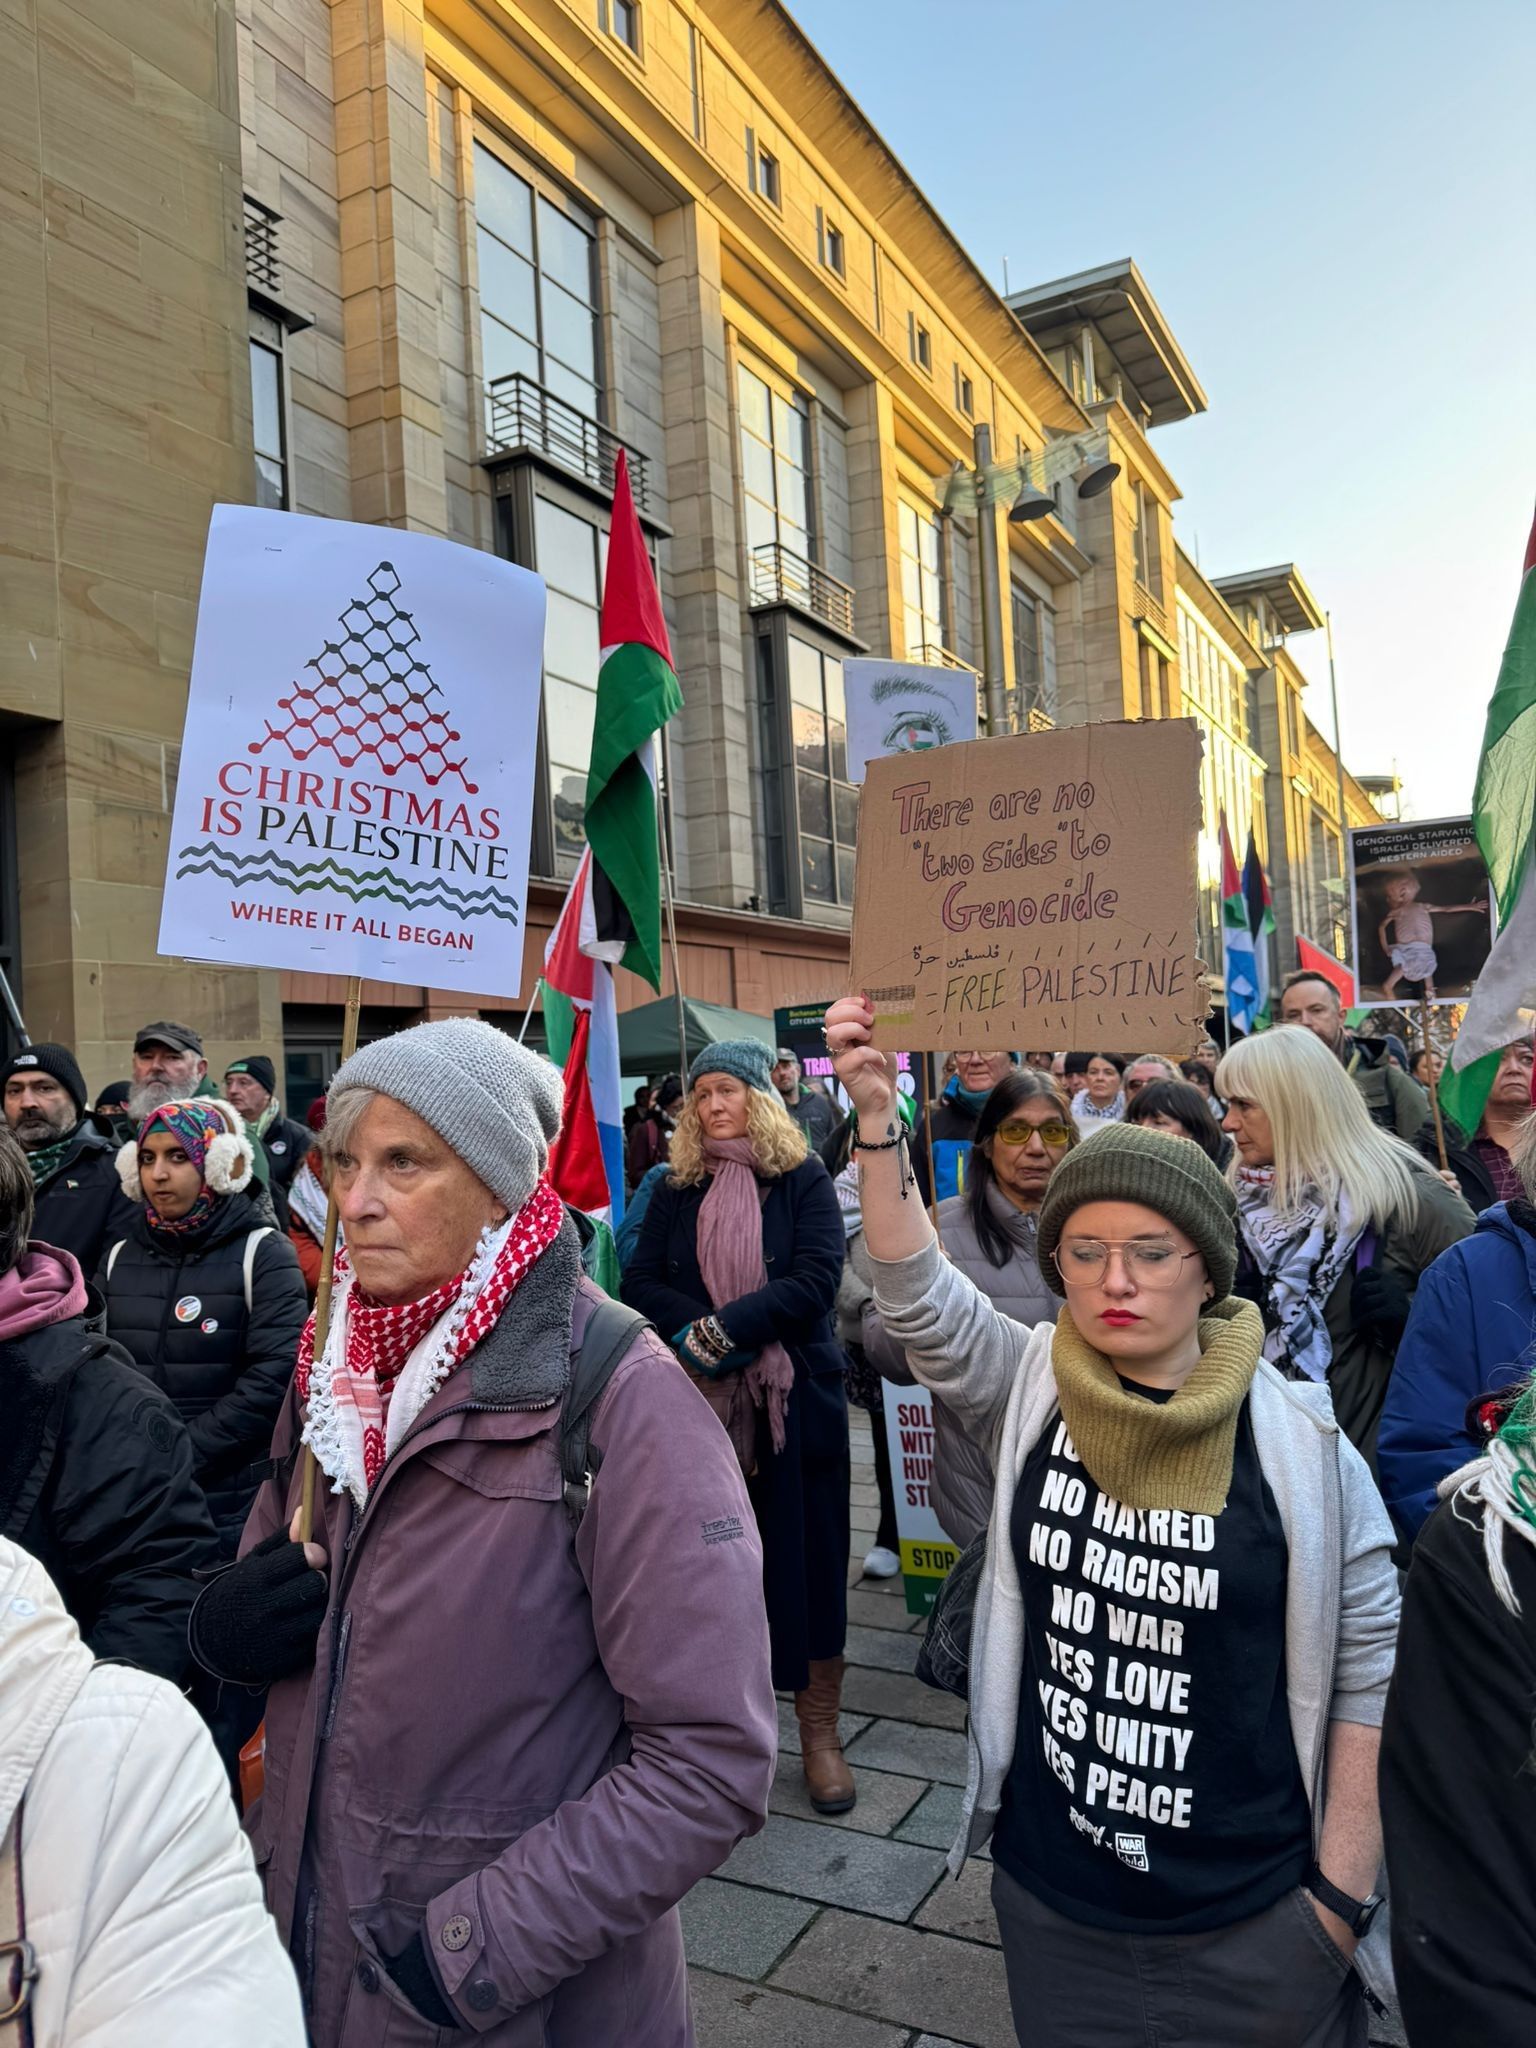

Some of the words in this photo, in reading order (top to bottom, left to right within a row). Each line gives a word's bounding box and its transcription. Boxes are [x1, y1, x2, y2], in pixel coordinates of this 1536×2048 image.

[218, 761, 500, 840] CHRISTMAS
[892, 780, 974, 834] There
[988, 787, 1042, 821] are
[1053, 780, 1096, 813] no
[200, 798, 243, 836] IS
[258, 805, 509, 880] PALESTINE
[1070, 818, 1110, 861] to
[1355, 833, 1415, 847] GENOCIDAL
[1369, 844, 1409, 855] ISRAELI
[1412, 837, 1471, 850] DELIVERED
[1378, 852, 1427, 863] WESTERN
[1430, 848, 1463, 858] AIDED
[231, 900, 318, 929] WHERE
[325, 913, 347, 931] IT
[352, 917, 391, 939] ALL
[398, 925, 474, 951] BEGAN
[942, 872, 1118, 933] Genocide
[913, 945, 941, 976] حرة
[946, 944, 1000, 969] فلسطين
[943, 965, 1008, 1014] FREE
[1022, 955, 1186, 1009] PALESTINE
[790, 1018, 803, 1026] CITY
[1039, 1469, 1087, 1518] NO
[912, 1548, 955, 1570] STOP
[1029, 1521, 1073, 1573] NO
[1081, 1537, 1220, 1612] RACISM
[1050, 1584, 1096, 1636] NO
[1106, 1602, 1185, 1657] WAR
[1045, 1631, 1095, 1694] YES
[1105, 1656, 1192, 1714] LOVE
[1037, 1678, 1087, 1744] YES
[1096, 1711, 1194, 1772] UNITY
[1042, 1724, 1076, 1795] YES
[1086, 1762, 1193, 1829] PEACE
[1119, 1838, 1143, 1851] WAR
[1120, 1854, 1145, 1868] child
